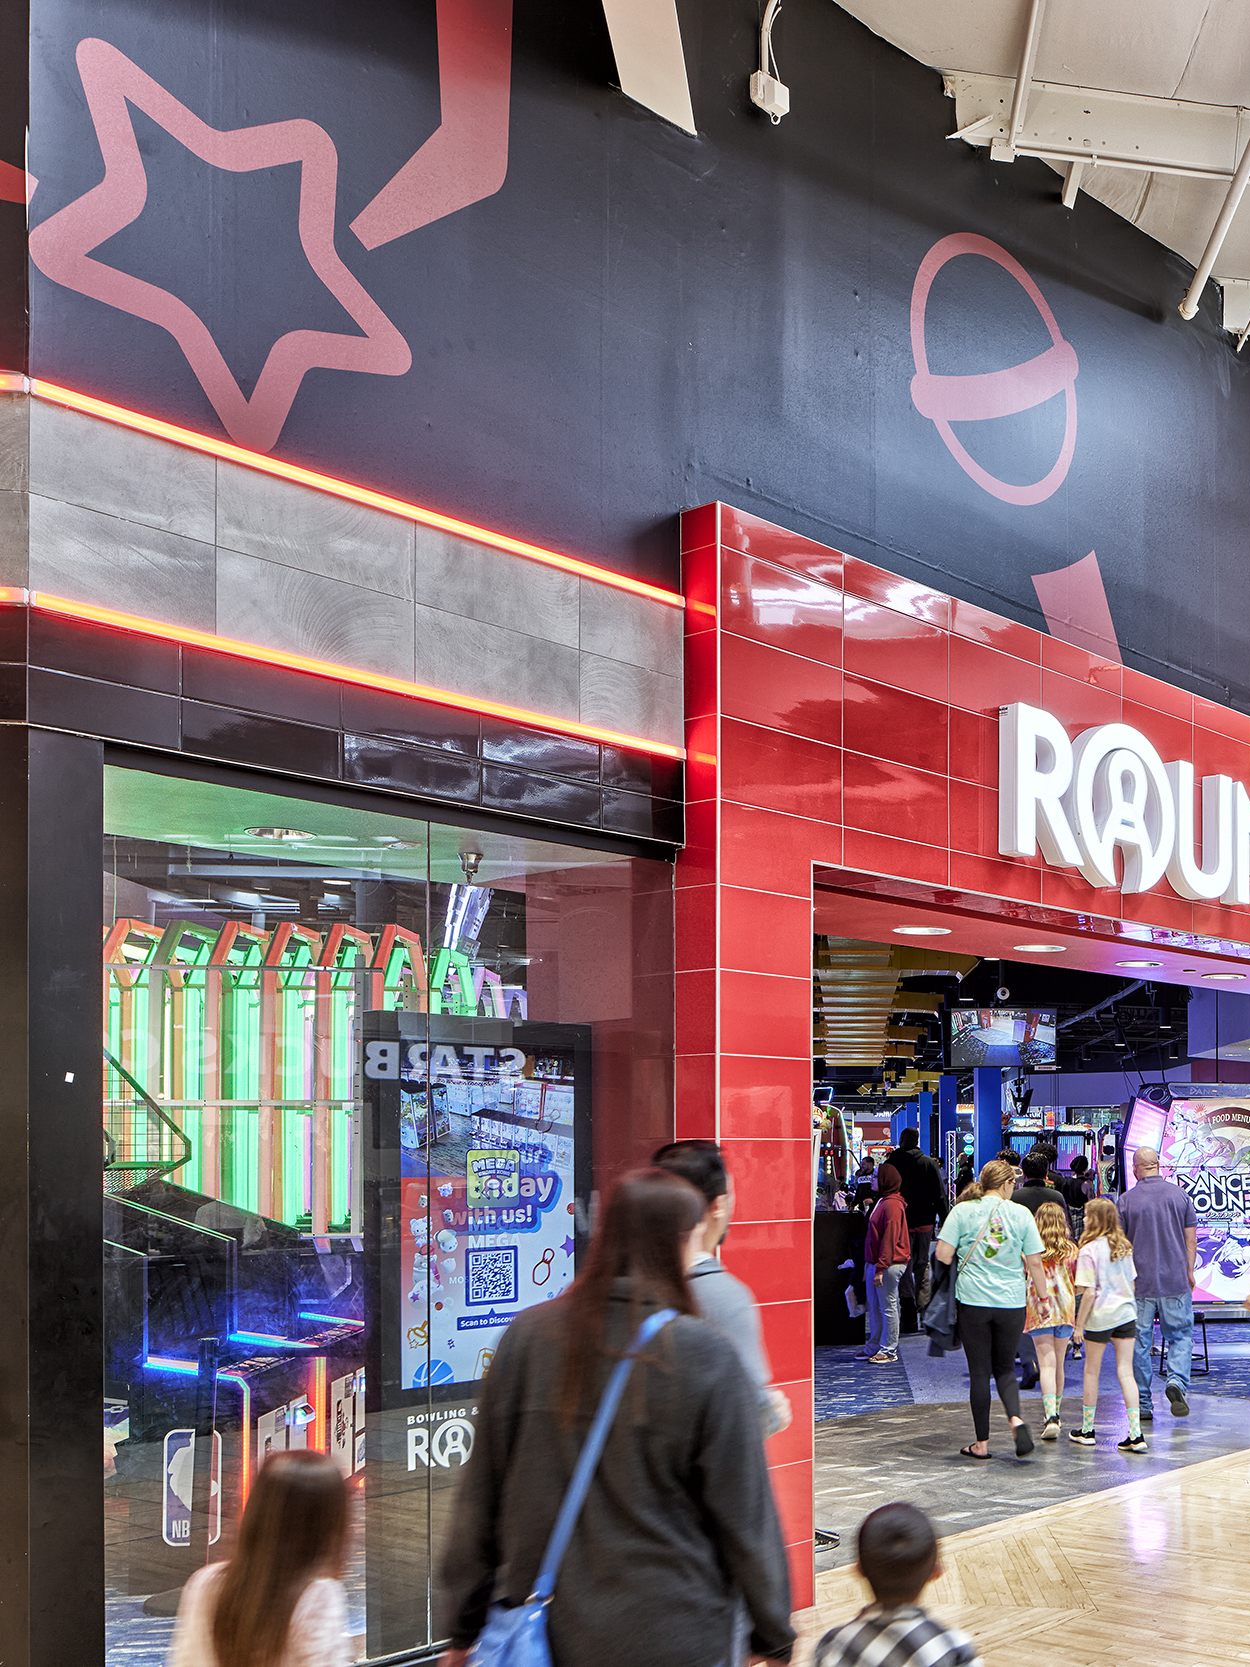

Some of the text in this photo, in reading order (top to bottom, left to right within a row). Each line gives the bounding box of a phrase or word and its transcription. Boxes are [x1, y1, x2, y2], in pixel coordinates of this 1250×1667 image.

[1212, 1113, 1231, 1125] FOOD
[471, 1157, 516, 1173] MEGA
[502, 1204, 533, 1224] us!
[460, 1319, 479, 1328] Scan
[479, 1317, 489, 1326] to
[407, 1408, 467, 1426] BOWLING
